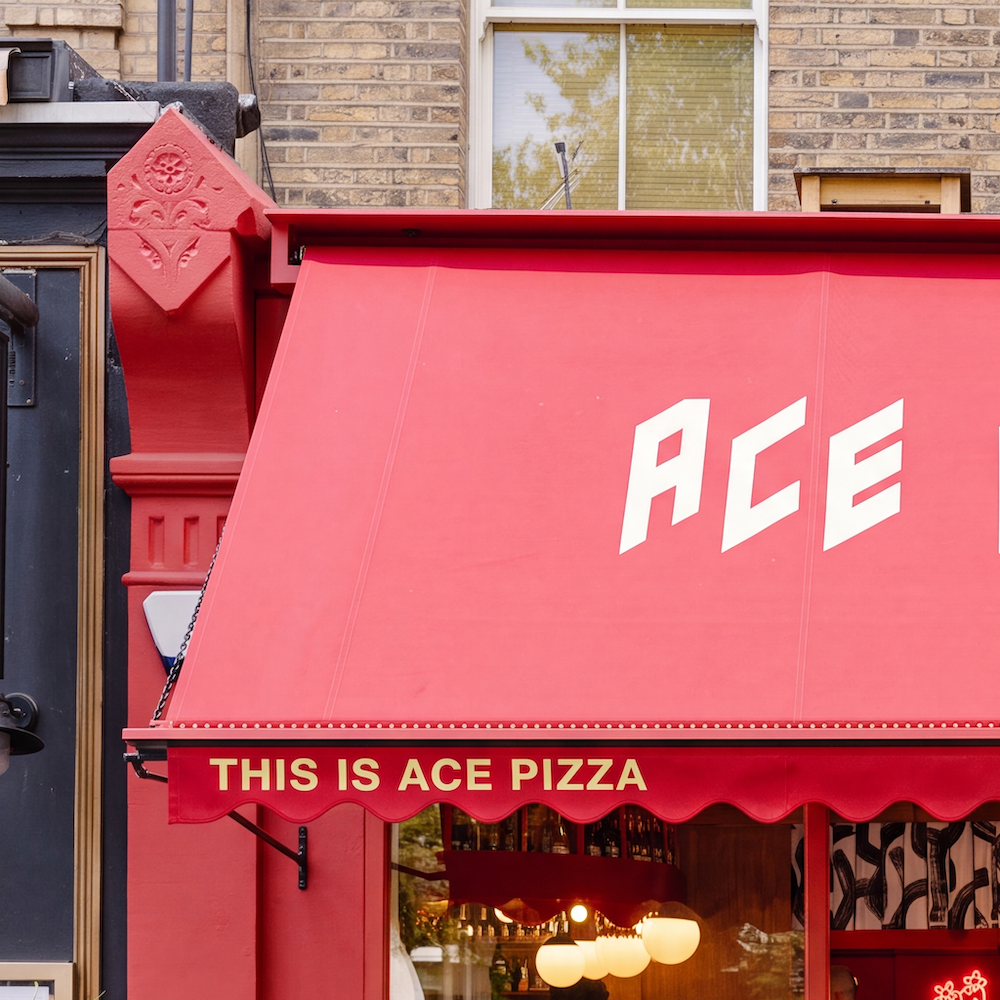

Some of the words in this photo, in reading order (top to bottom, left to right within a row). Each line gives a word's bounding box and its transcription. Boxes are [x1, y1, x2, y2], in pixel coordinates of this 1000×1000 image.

[618, 396, 904, 555] ACE
[209, 758, 319, 792] THIS
[338, 758, 380, 792] IS
[397, 758, 493, 792] ACE
[511, 758, 648, 792] PIZZA
